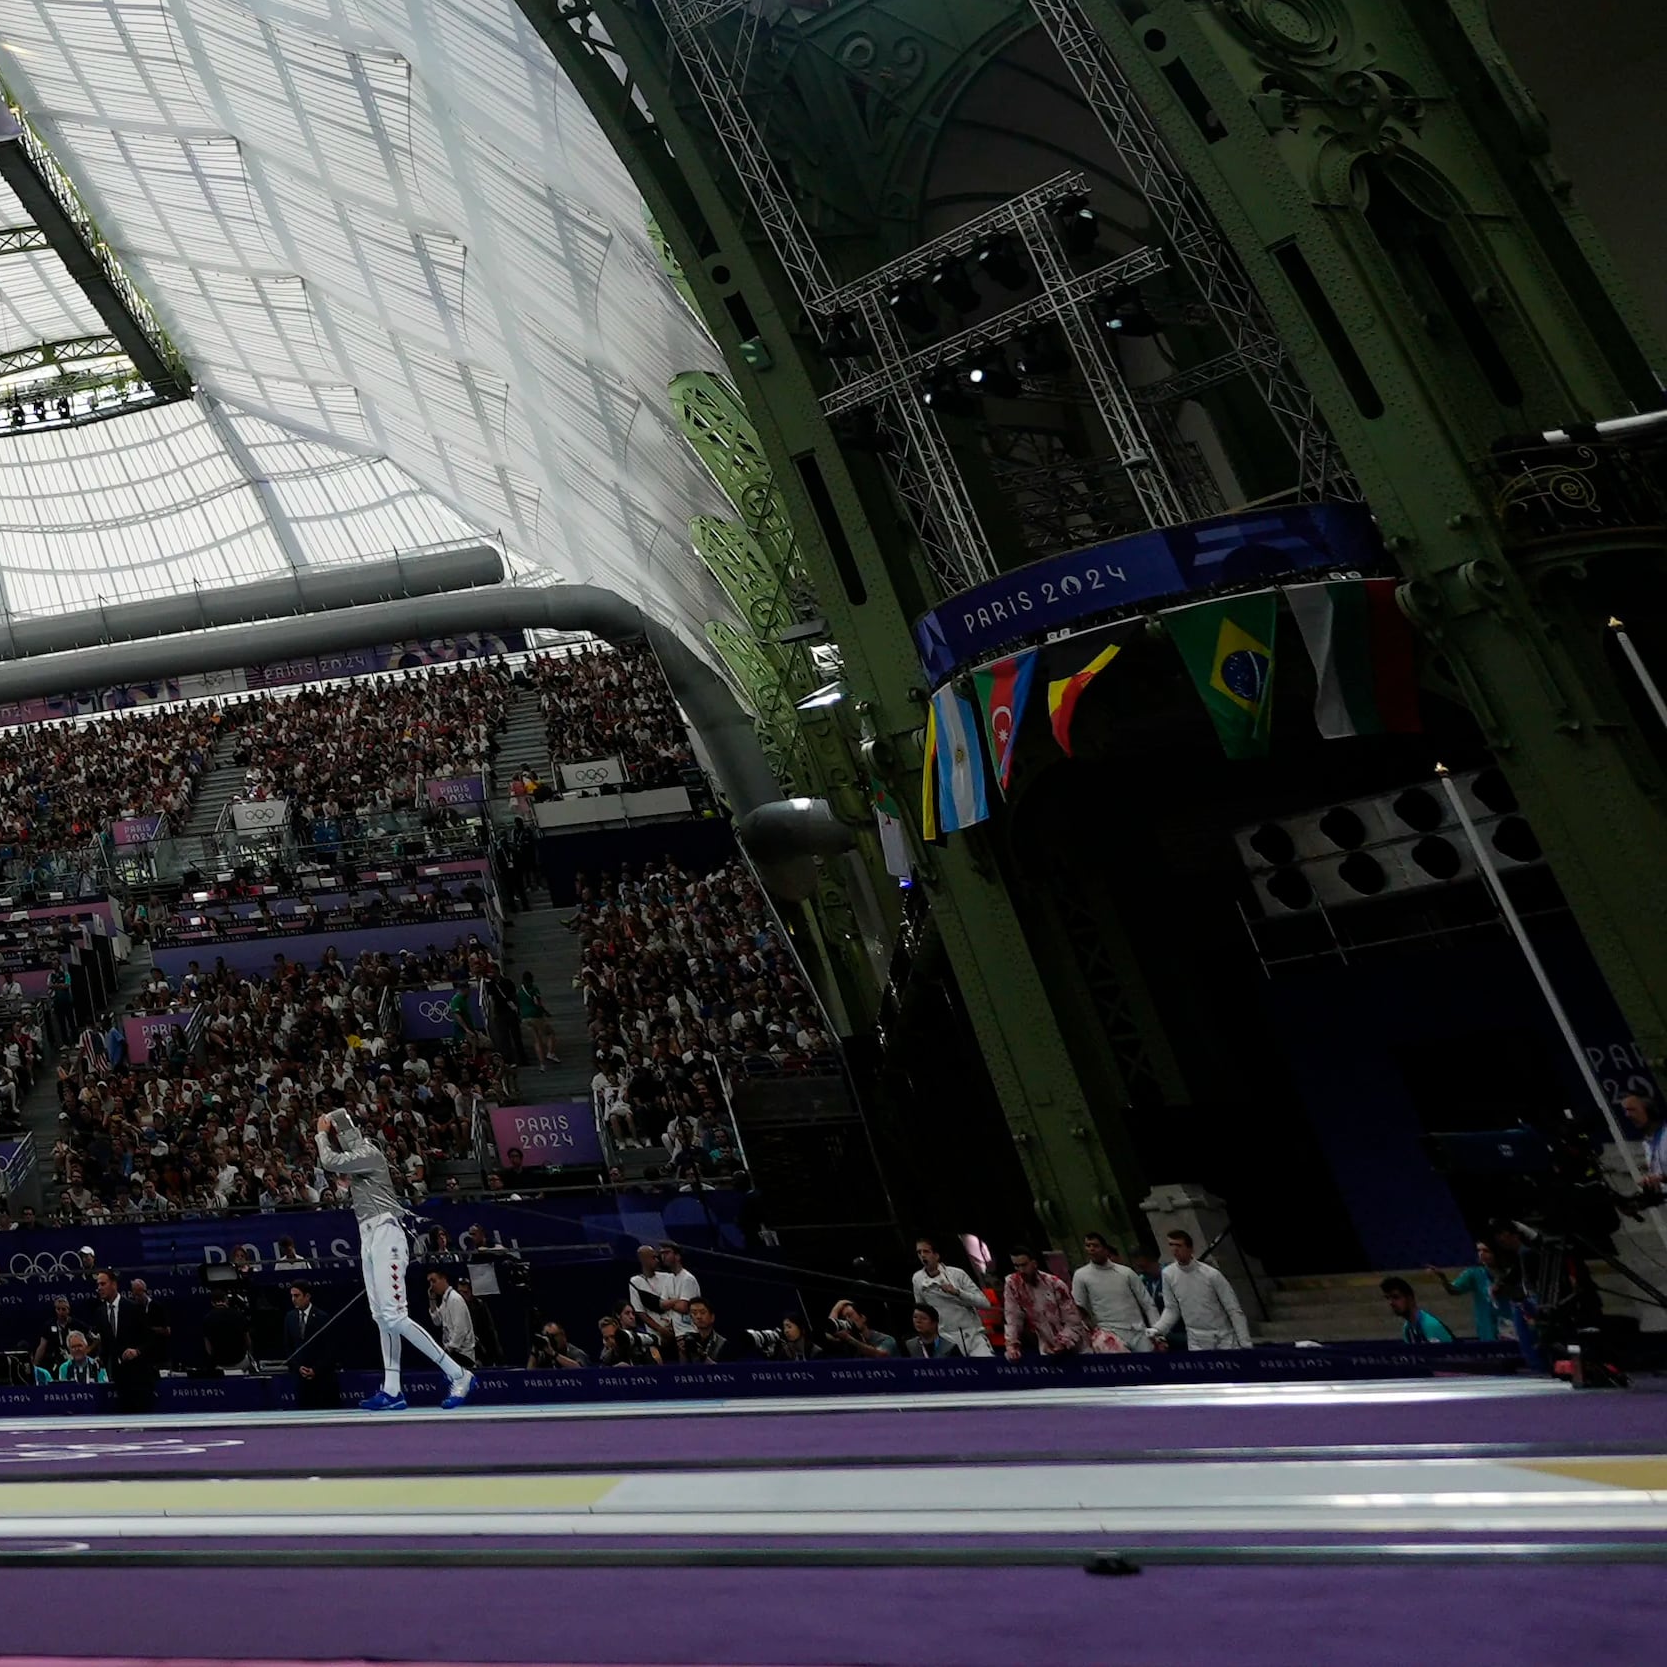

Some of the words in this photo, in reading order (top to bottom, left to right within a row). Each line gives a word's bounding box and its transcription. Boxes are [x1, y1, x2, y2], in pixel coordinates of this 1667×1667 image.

[963, 591, 1034, 635] PARIS
[1041, 564, 1127, 605] 2024
[265, 662, 313, 680] PARIS
[320, 655, 366, 673] 2024
[124, 823, 152, 834] PARIS
[142, 1023, 172, 1036] PARI
[514, 1115, 569, 1132] PARIS
[520, 1132, 575, 1150] 2024
